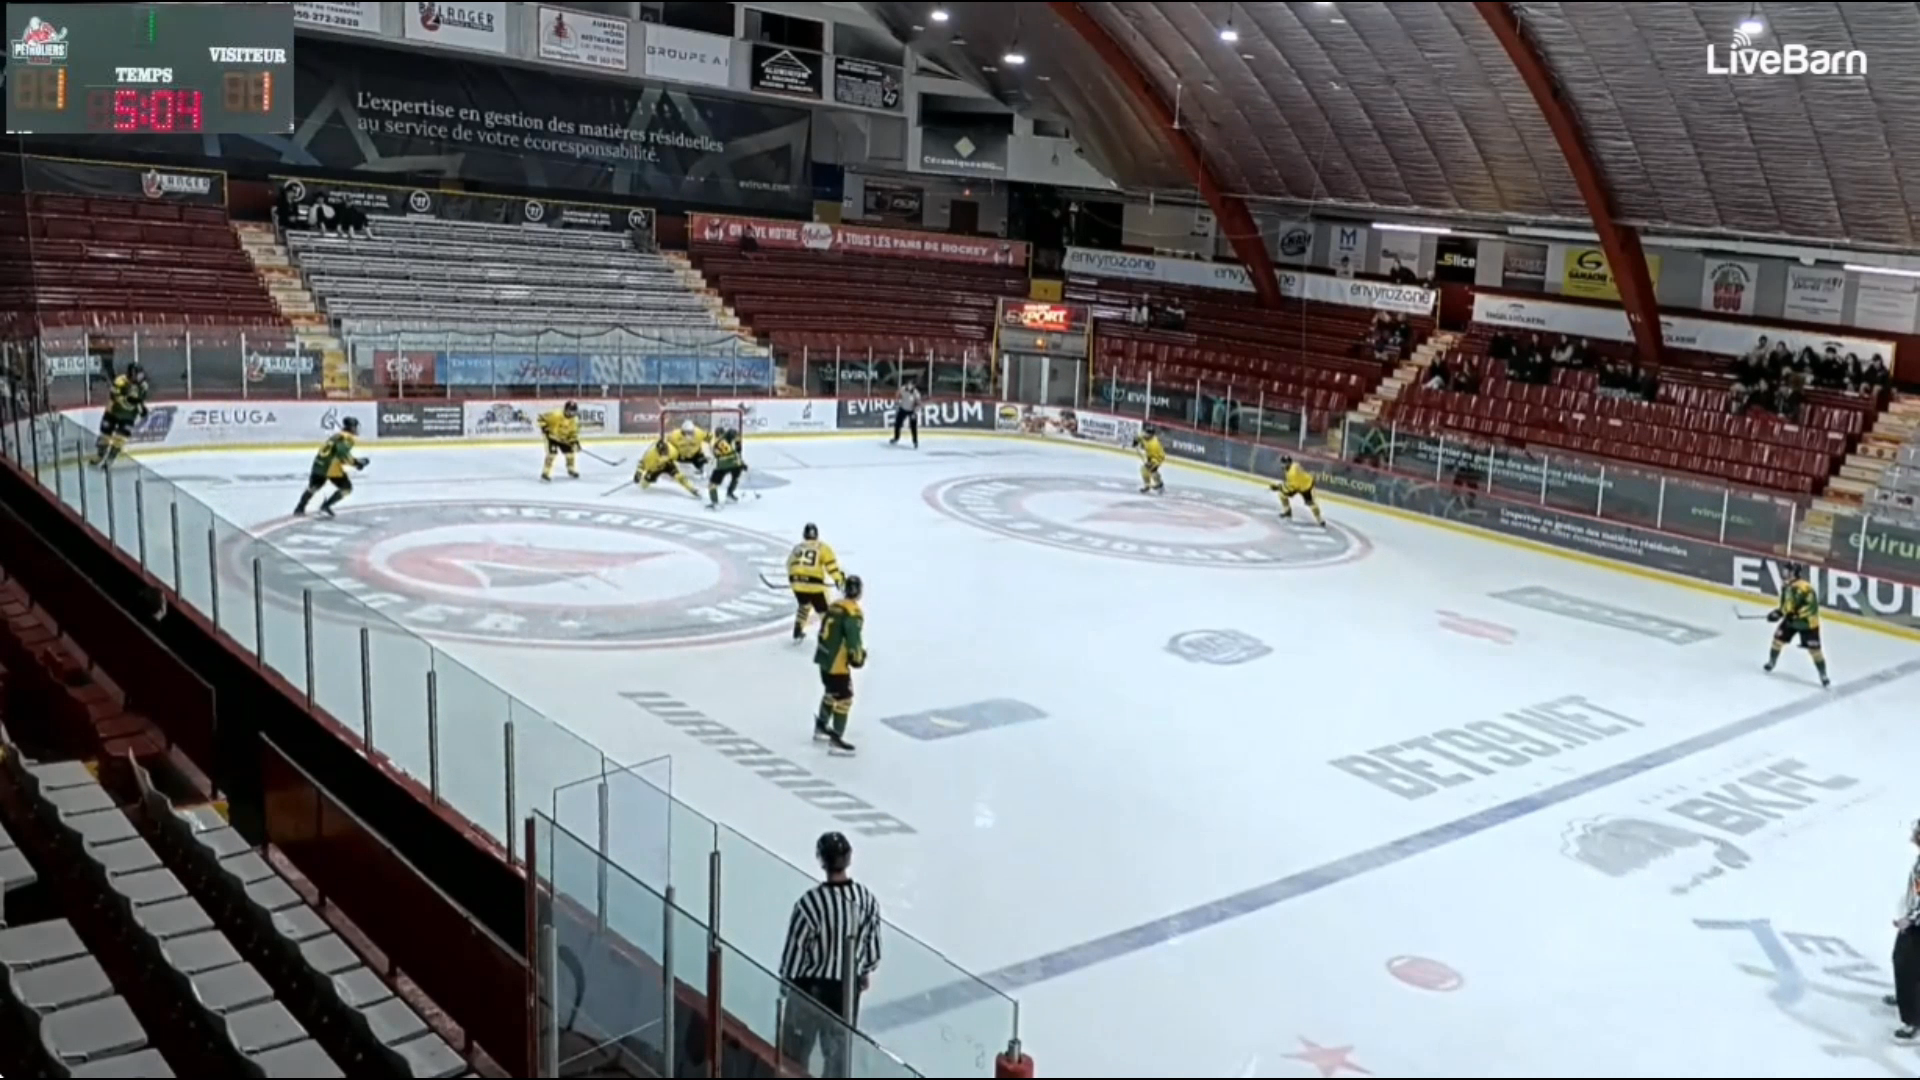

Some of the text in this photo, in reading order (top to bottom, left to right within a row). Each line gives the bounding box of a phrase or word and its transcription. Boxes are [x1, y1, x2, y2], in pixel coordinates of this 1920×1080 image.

[646, 45, 706, 64] GROUPE
[357, 91, 724, 153] L'expertise en gestion des matières résiduelles
[357, 116, 660, 163] au service de votre écoresponsabilité.
[846, 233, 871, 246] TOUS
[873, 235, 892, 248] LES
[941, 243, 988, 256] HOCKEY
[1071, 250, 1156, 271] envyrozone
[1444, 253, 1476, 268] Slice
[1350, 282, 1431, 305] envyrozone
[616, 690, 918, 837] WARRIOR
[1327, 693, 1645, 801] BET99.NET
[1667, 757, 1861, 836] BKFC
